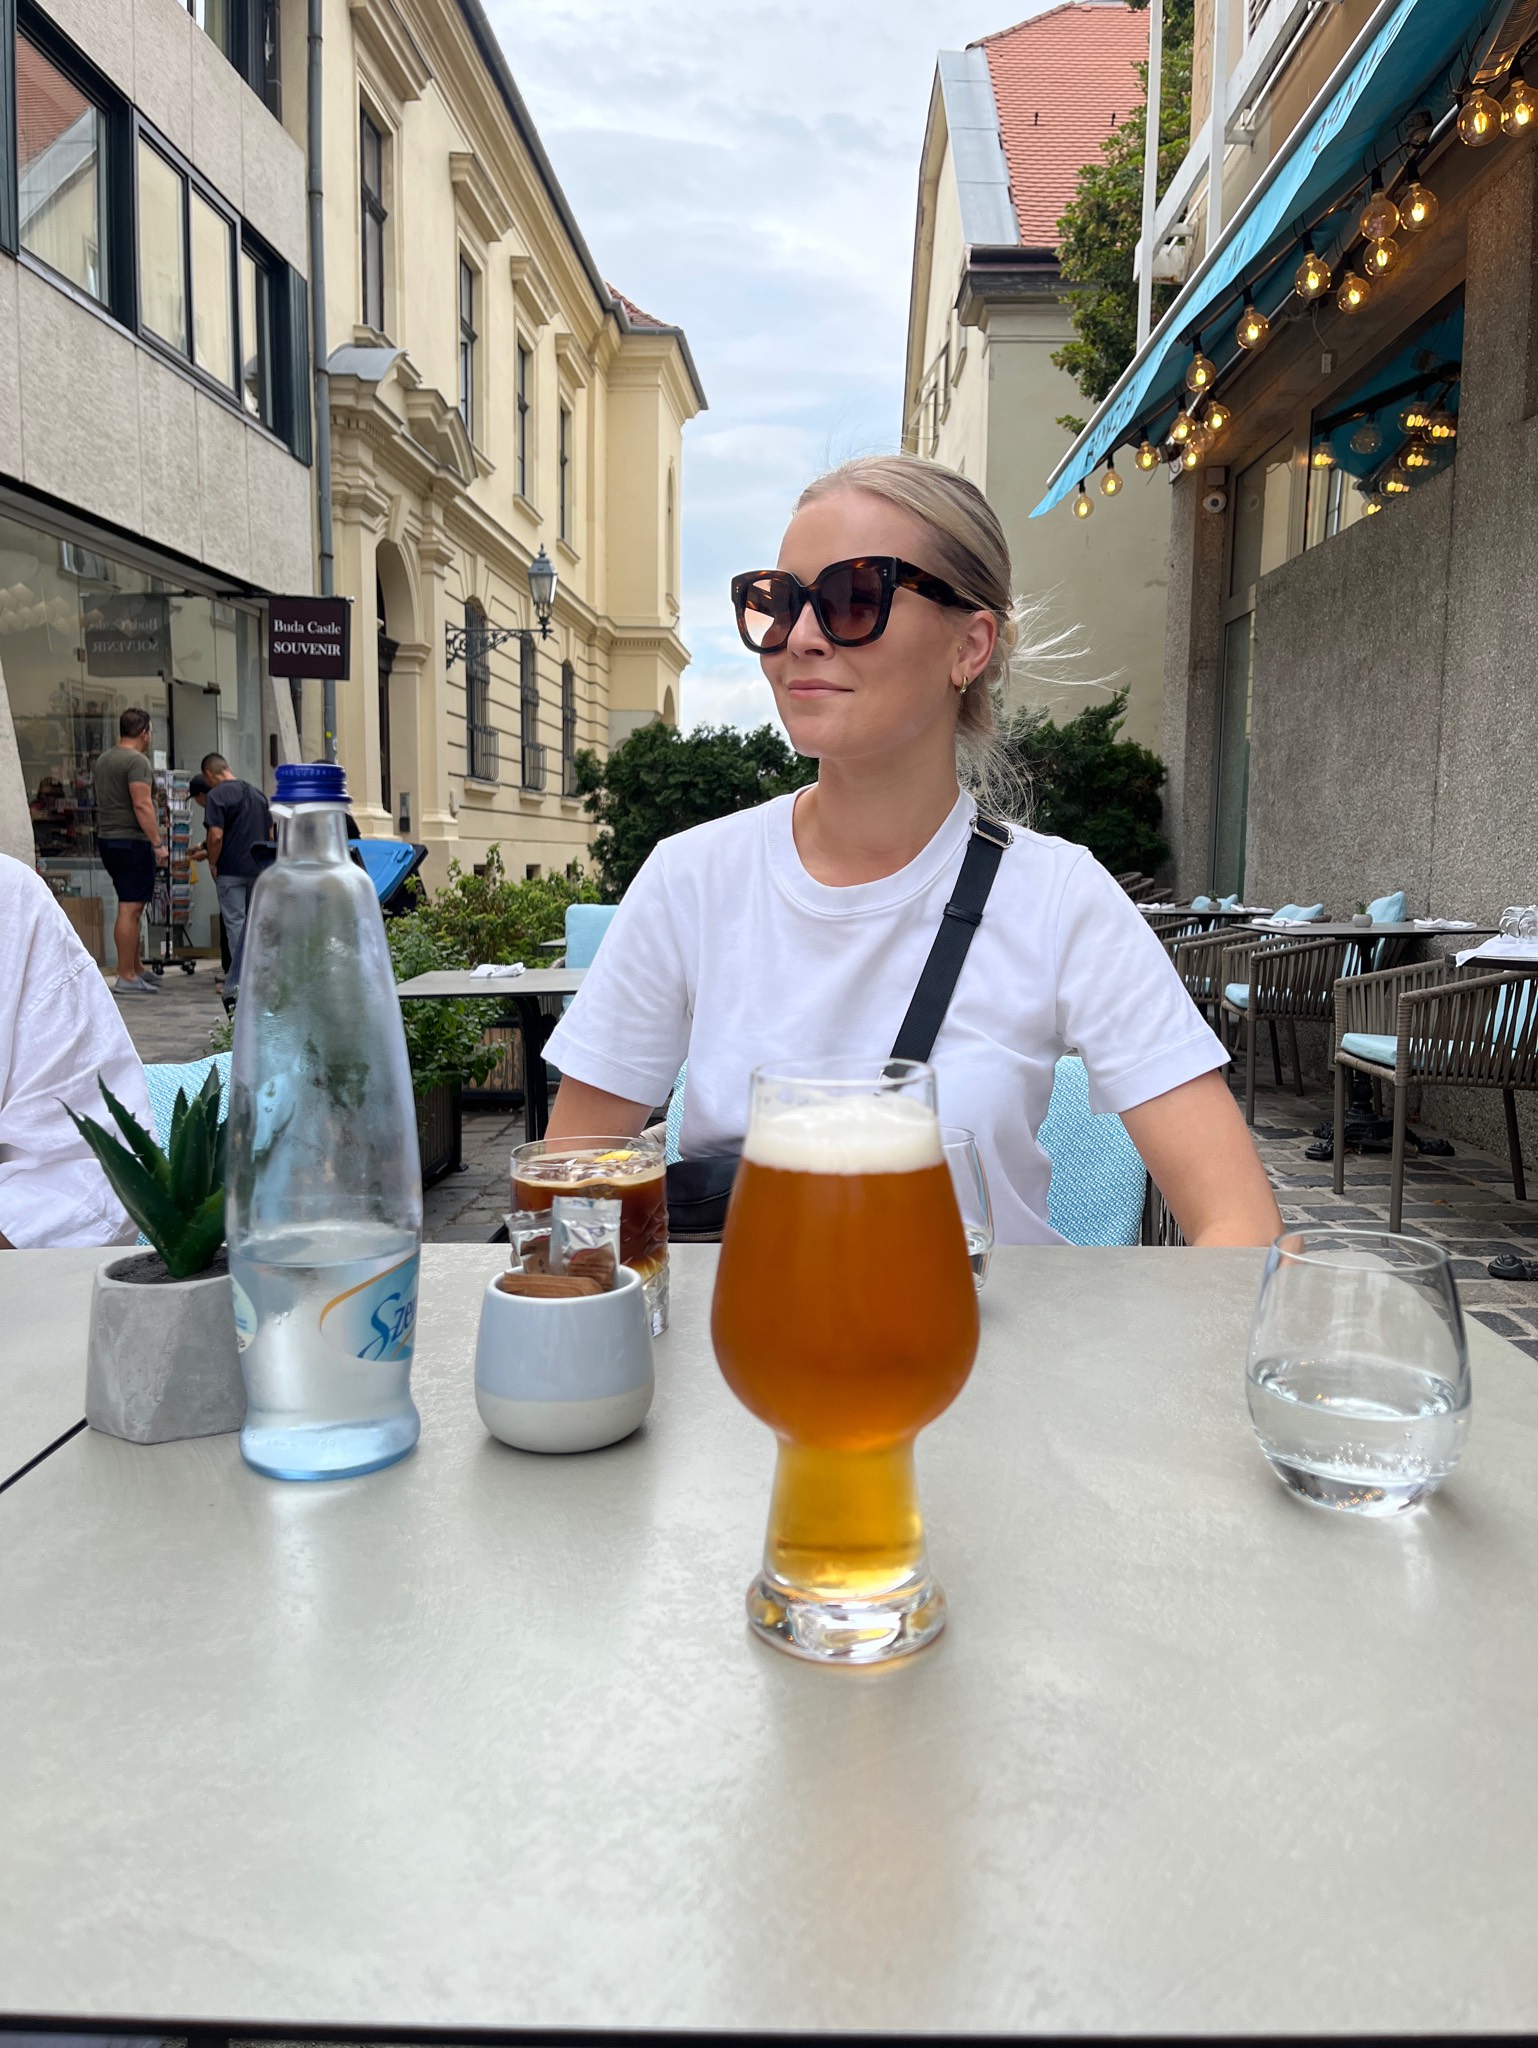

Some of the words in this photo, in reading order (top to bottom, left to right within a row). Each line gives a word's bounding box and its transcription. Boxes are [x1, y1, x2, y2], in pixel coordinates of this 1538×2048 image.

[274, 619, 305, 634] Buda
[307, 620, 342, 636] Castle
[273, 640, 341, 657] SOUVENIR
